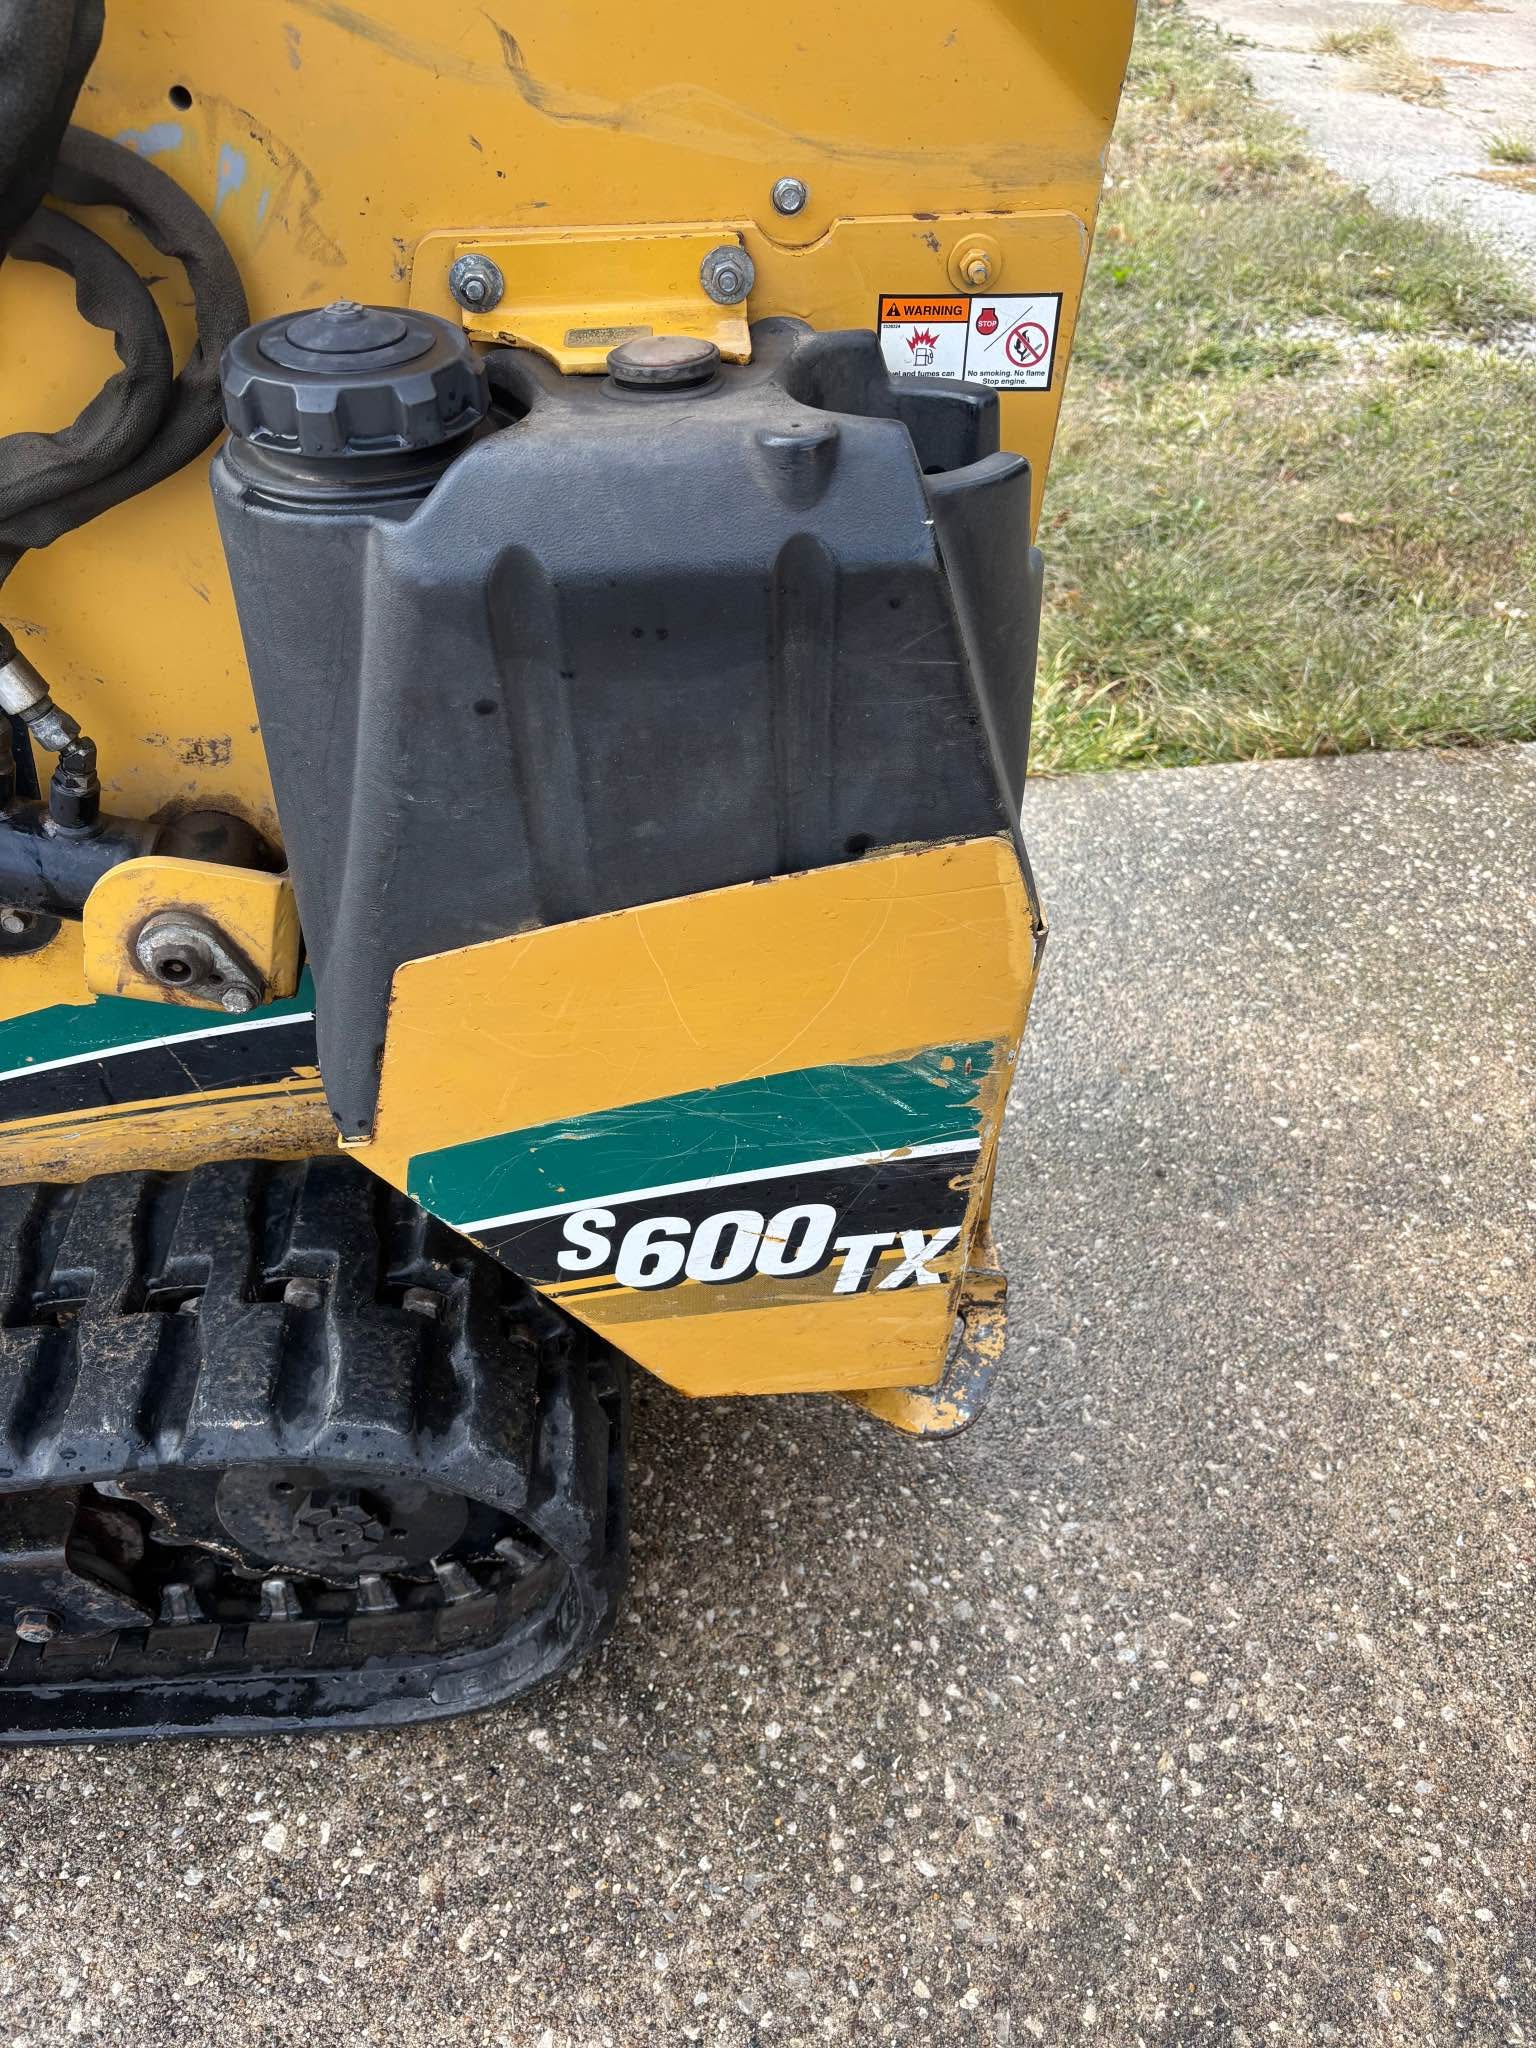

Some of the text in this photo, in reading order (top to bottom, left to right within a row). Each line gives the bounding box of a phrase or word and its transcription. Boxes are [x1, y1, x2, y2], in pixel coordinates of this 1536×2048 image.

[903, 305, 963, 316] WARNING
[979, 370, 1013, 378] smoking.
[1001, 378, 1027, 386] engine.
